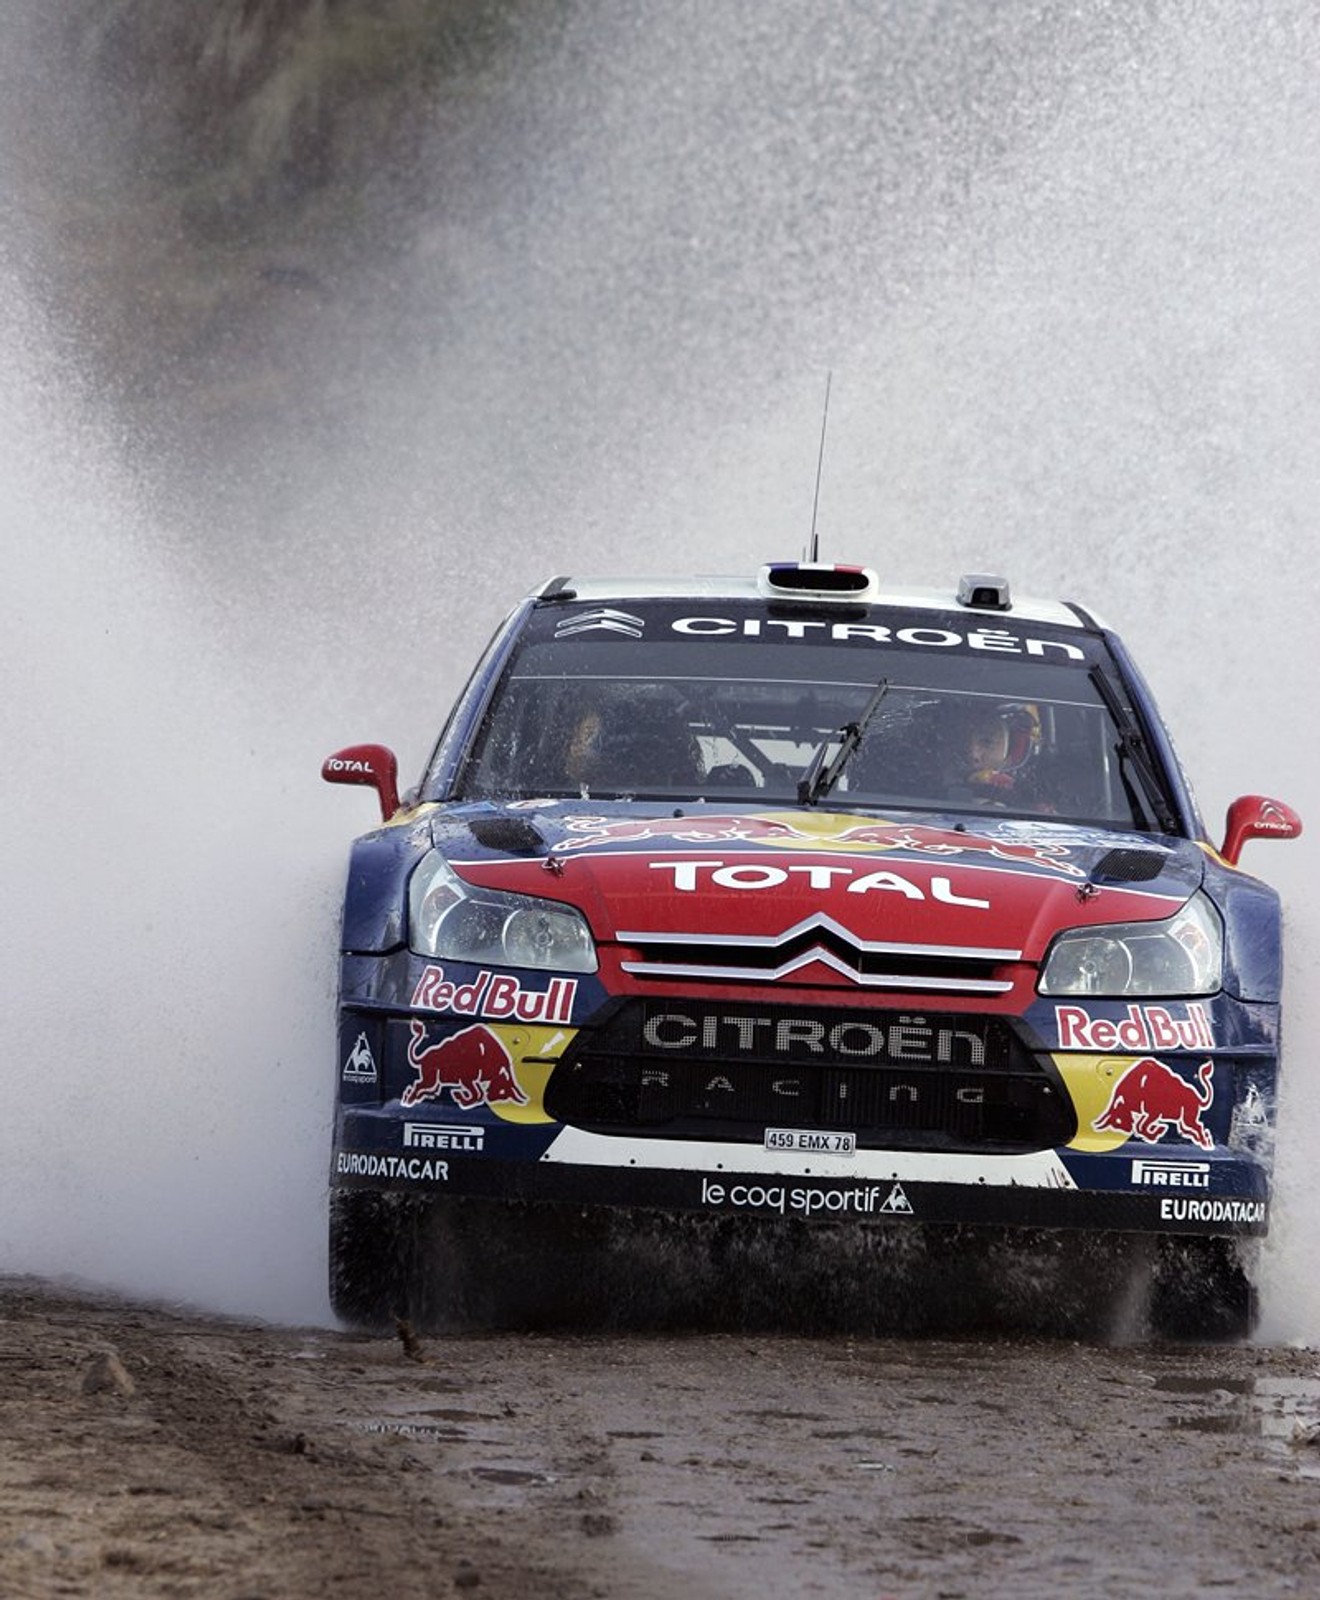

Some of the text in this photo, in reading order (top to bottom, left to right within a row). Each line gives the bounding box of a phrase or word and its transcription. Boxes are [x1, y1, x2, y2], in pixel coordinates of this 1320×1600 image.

[327, 759, 374, 773] TOTAL
[649, 861, 990, 909] TOTAL
[410, 965, 578, 1024] Red Bull
[1055, 1003, 1215, 1049] Red Bull
[404, 1122, 485, 1150] PIRELLI
[769, 1133, 850, 1151] 459 EMX 78
[337, 1152, 449, 1181] EURODATACAR
[1131, 1159, 1210, 1187] PIRELLI
[702, 1178, 880, 1215] le coq sportif
[1160, 1199, 1266, 1222] EURODATACAR
